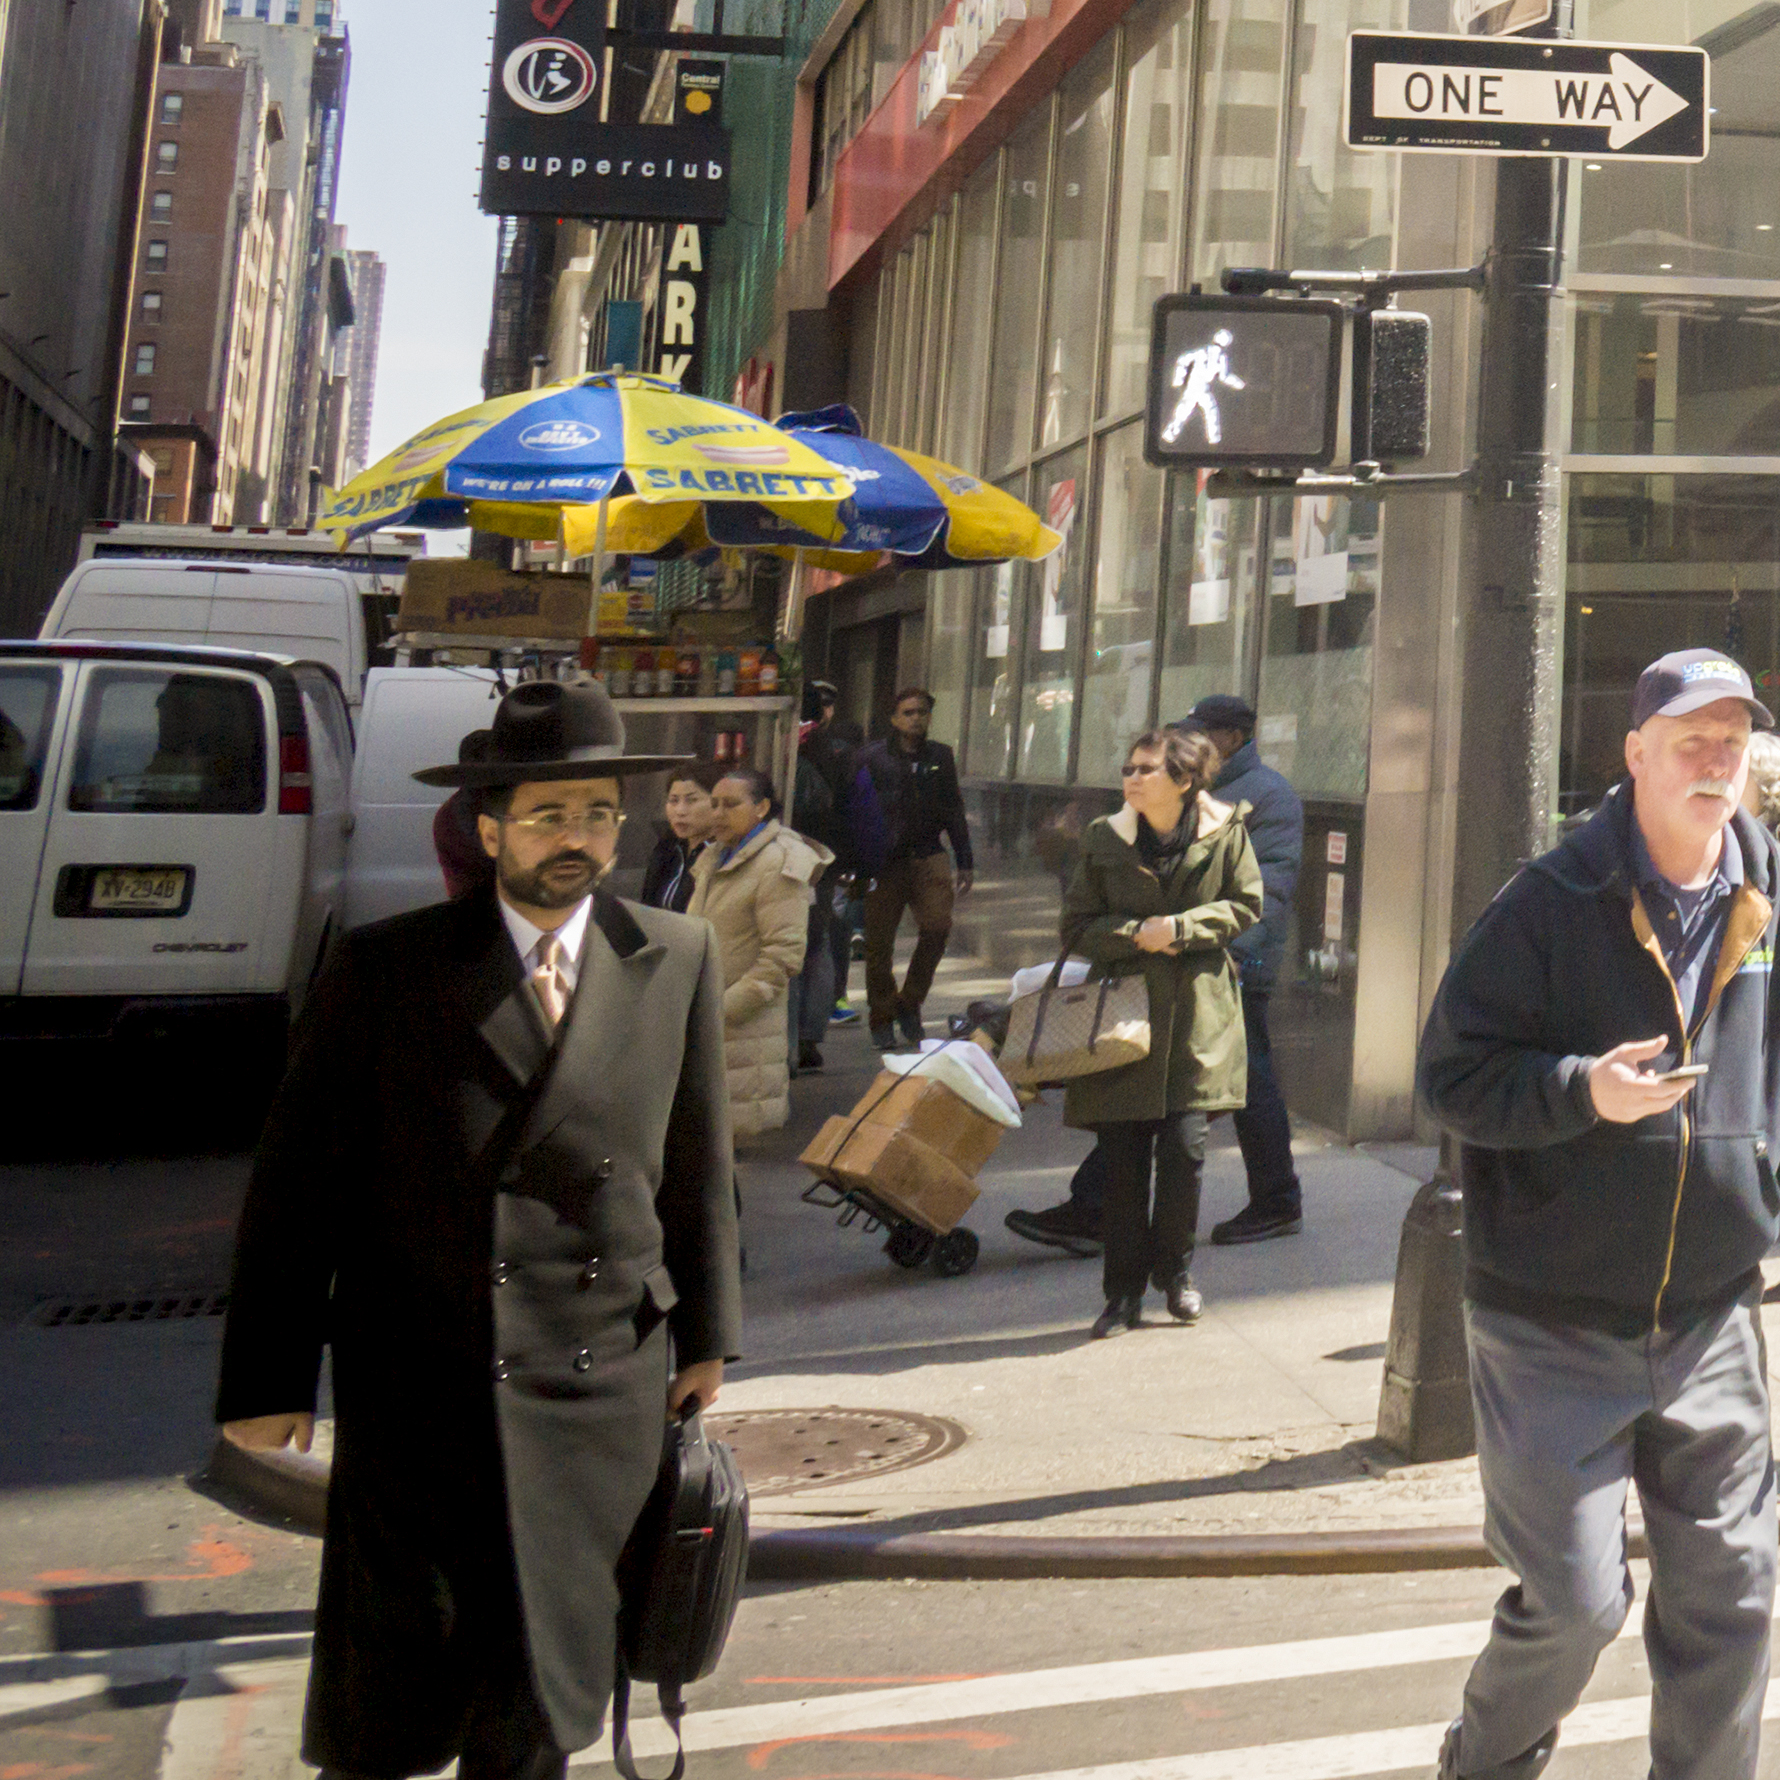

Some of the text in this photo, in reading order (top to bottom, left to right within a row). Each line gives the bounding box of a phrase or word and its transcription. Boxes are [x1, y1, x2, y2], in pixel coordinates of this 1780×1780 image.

[680, 72, 721, 85] Central
[1404, 70, 1654, 123] ONE WAY
[496, 152, 723, 181] supperclub
[646, 423, 759, 446] SABRETT
[647, 469, 836, 497] SABRETT
